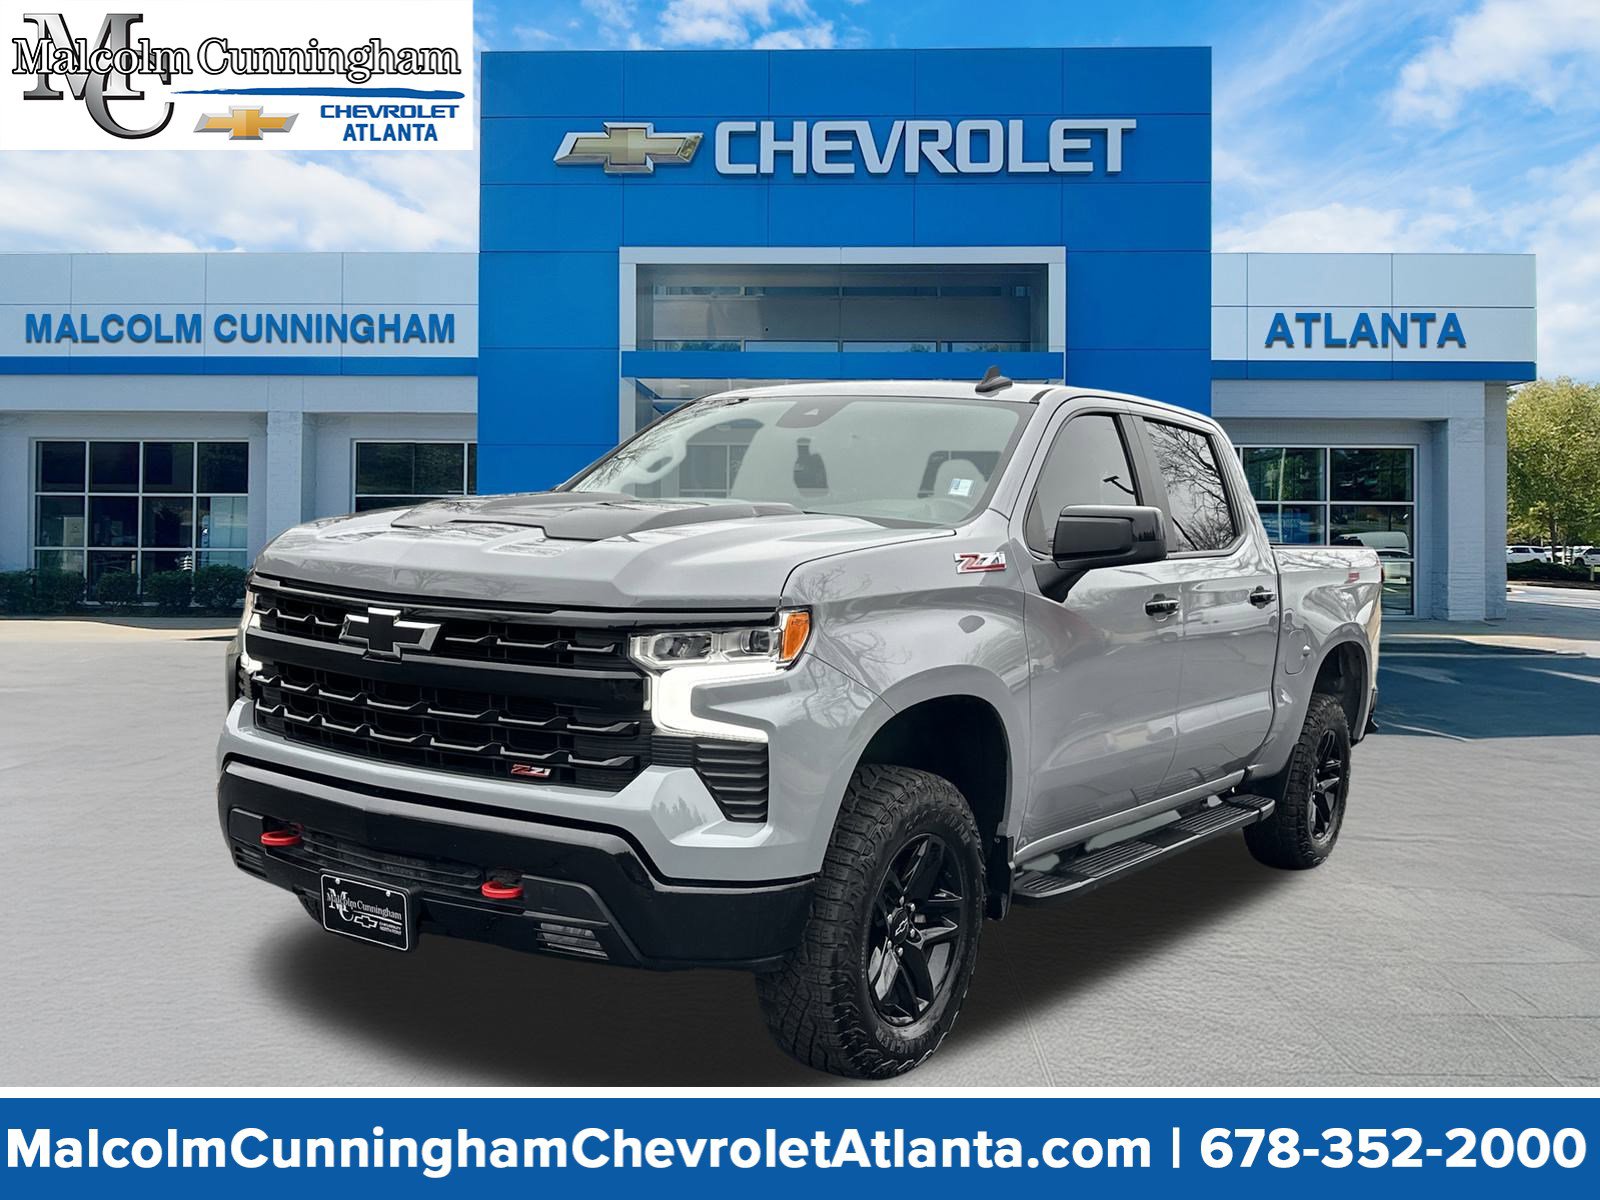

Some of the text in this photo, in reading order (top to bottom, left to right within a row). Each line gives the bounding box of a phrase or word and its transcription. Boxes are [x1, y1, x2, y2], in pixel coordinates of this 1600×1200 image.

[714, 118, 1137, 175] CHEVROLET
[25, 313, 456, 343] MALCOLM CUNNINGHAM
[1264, 312, 1467, 348] ATLANTA
[953, 551, 1007, 574] Z71
[511, 763, 552, 779] Z71
[326, 891, 402, 920] Malcolm Cunningham
